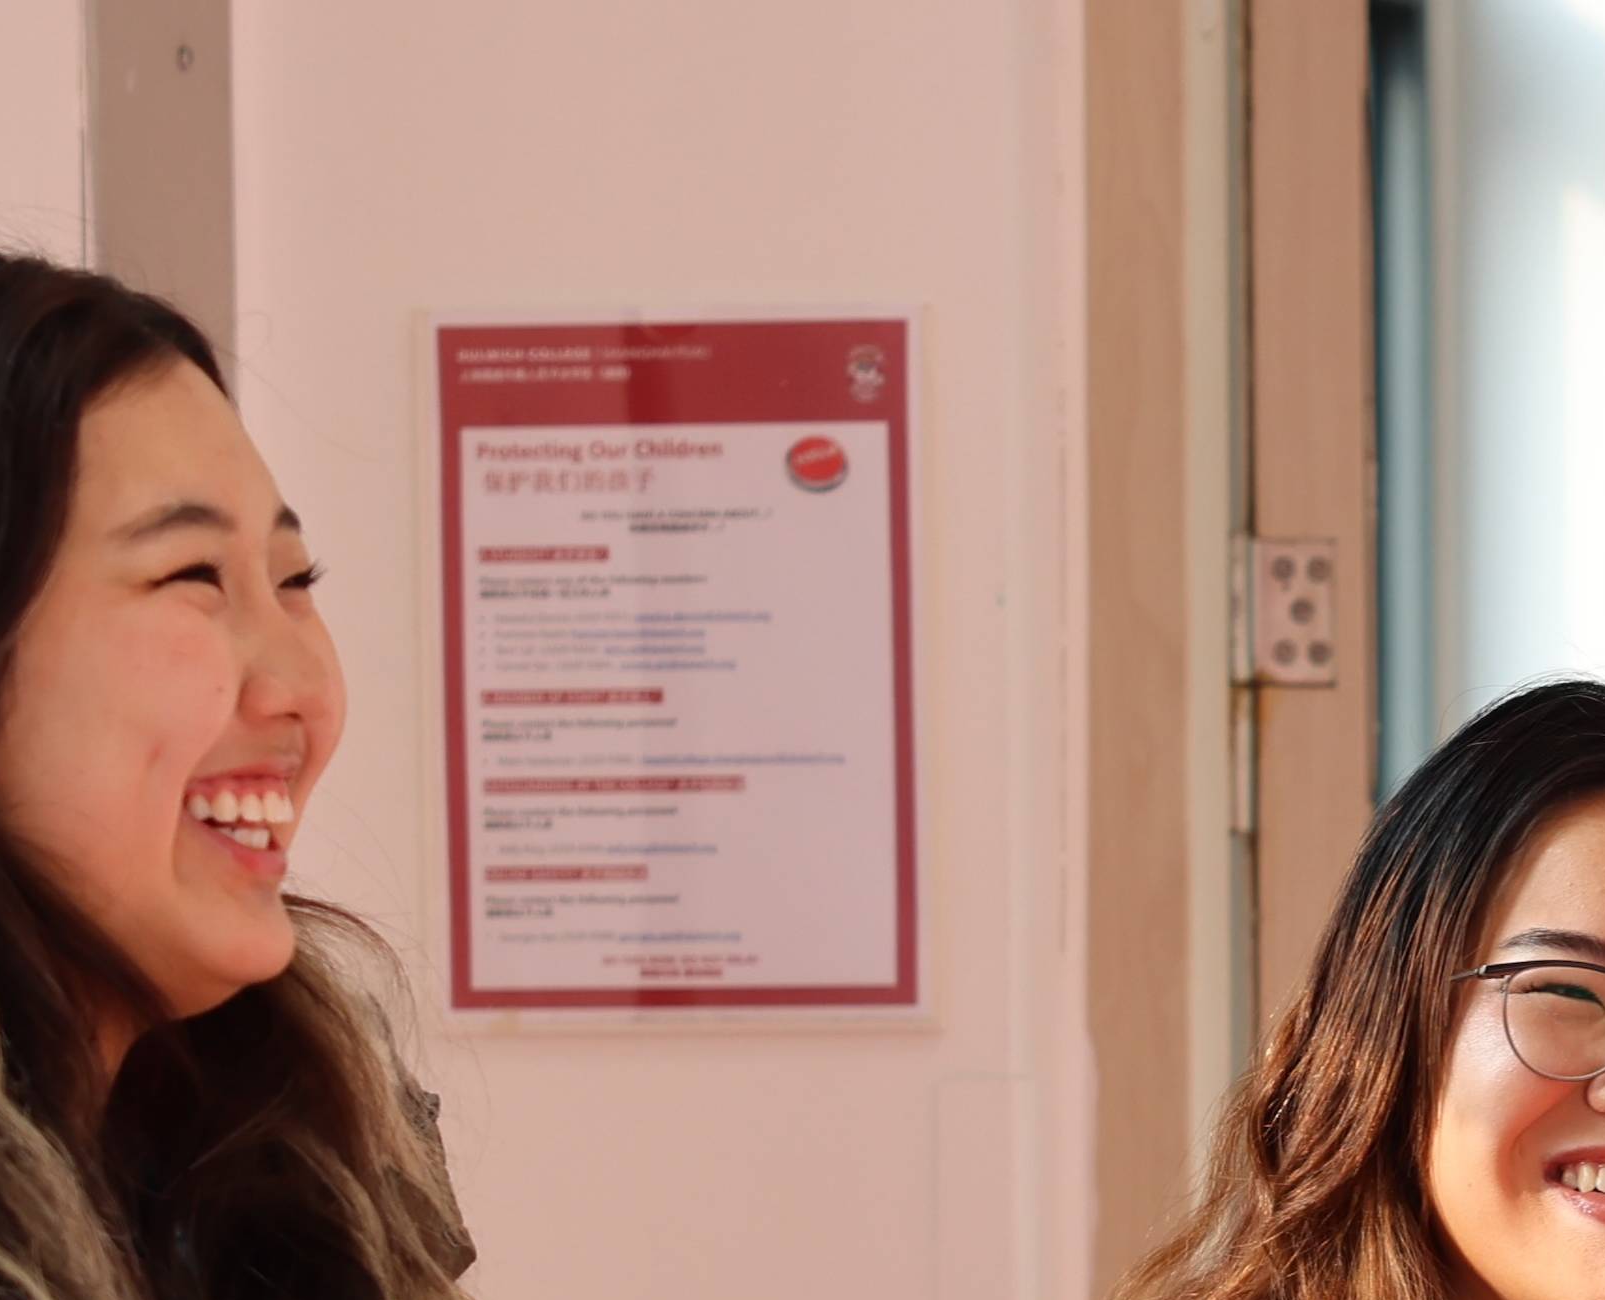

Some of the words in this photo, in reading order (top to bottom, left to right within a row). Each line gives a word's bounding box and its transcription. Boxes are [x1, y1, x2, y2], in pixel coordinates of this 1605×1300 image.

[476, 441, 582, 462] Protecting
[589, 440, 628, 459] Our
[634, 437, 723, 459] Children
[484, 466, 655, 493] 保护我们的孩子
